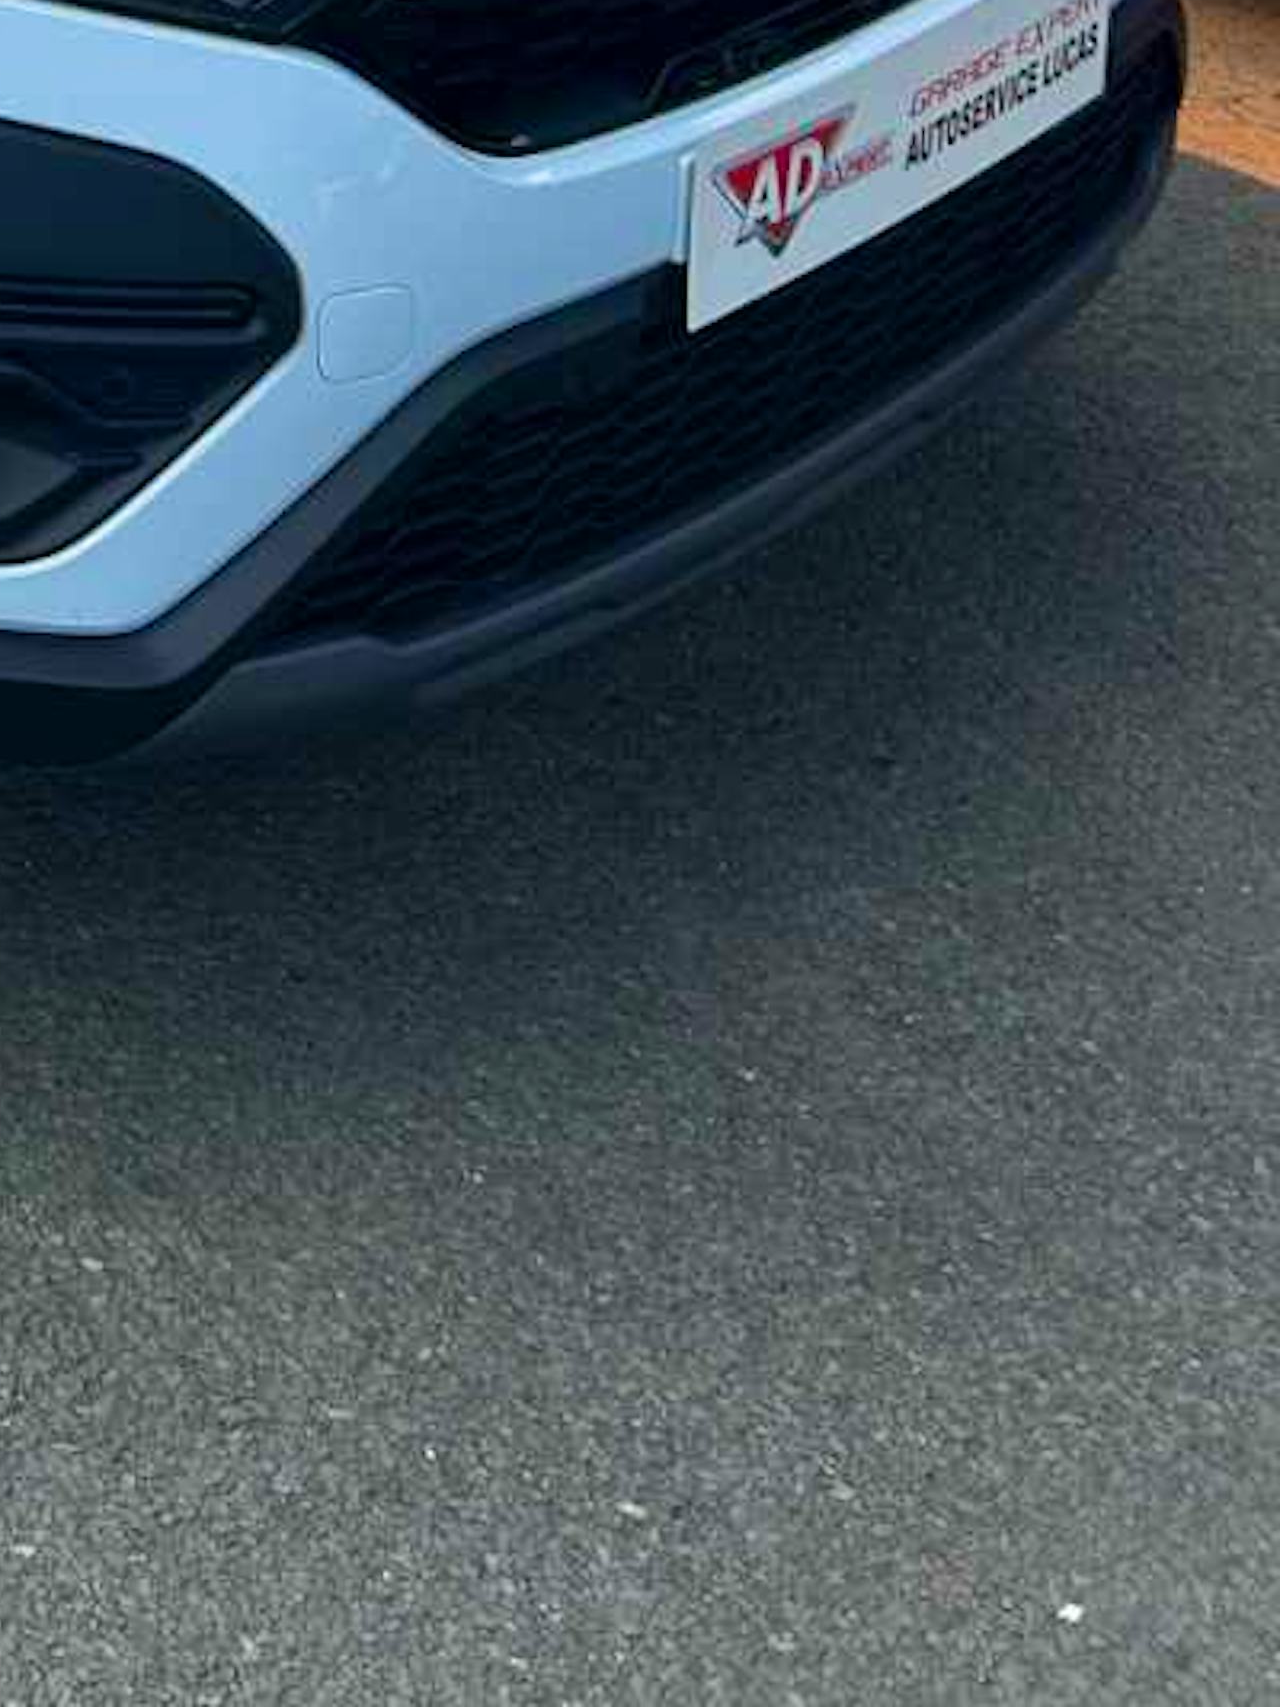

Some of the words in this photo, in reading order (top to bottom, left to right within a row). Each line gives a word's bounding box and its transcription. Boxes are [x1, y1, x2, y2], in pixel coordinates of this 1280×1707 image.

[905, 61, 1039, 171] AUTOSERVICE
[1043, 22, 1098, 86] LUCAS
[737, 139, 824, 245] AD
